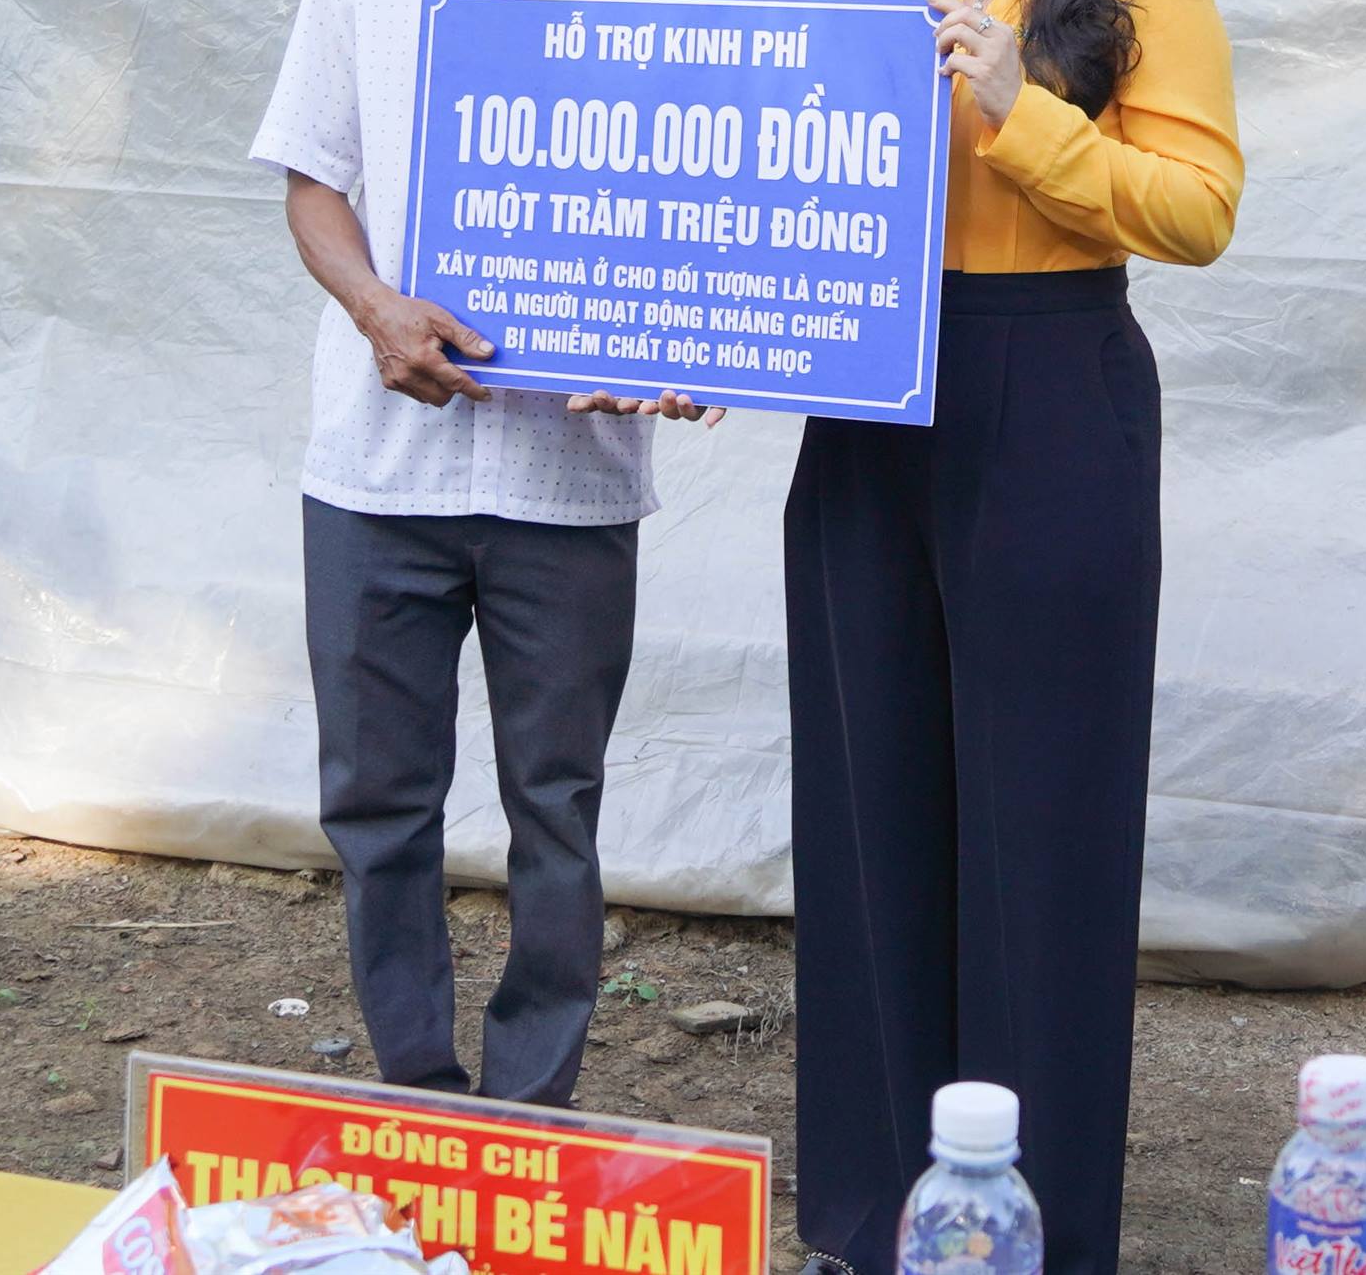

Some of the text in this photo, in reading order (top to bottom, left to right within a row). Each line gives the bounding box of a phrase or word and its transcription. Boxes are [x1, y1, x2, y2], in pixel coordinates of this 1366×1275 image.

[545, 11, 808, 69] HỖ TRỢ KINH PHÍ
[455, 84, 900, 187] 100.000.000 ĐỒNG
[454, 183, 887, 258] (MỘT TRĂM TRIỆU ĐỒNG)
[436, 250, 899, 308] XÂY DỰNG NHÀ Ở CHO ĐỐI TƯỢNG LÀ CON ĐẺ
[468, 281, 859, 341] CỦA NGƯỜI HOẠT ĐỘNG KHÁNG CHIẾN
[505, 324, 811, 377] BỊ NHIỄM CHẤT ĐỘC HÓA HỌC
[341, 1119, 560, 1183] ĐỒNG CHÍ
[387, 1179, 477, 1260] THỊ
[495, 1192, 566, 1260] BÉ
[585, 1204, 721, 1275] NĂM
